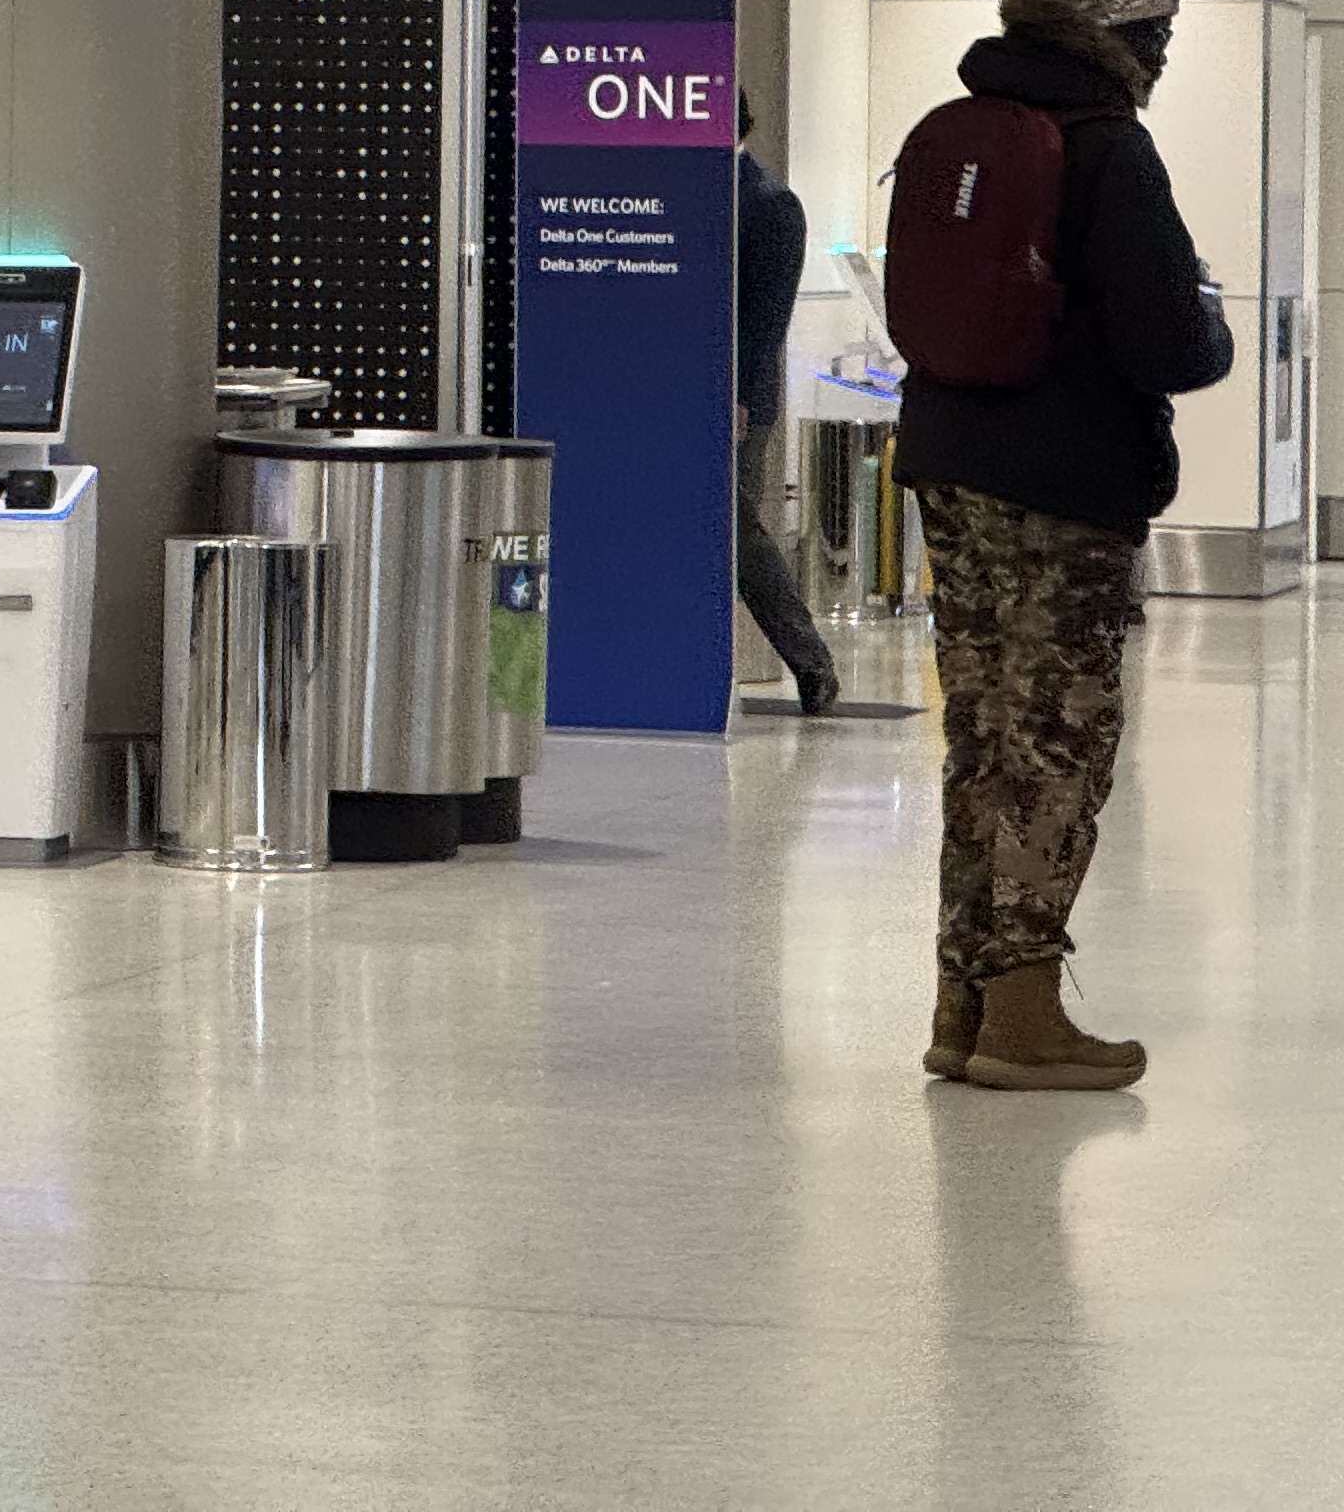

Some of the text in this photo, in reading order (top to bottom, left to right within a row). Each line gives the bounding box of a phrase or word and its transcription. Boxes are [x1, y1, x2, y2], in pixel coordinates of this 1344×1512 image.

[566, 45, 646, 63] DELTA
[588, 74, 711, 120] ONE
[540, 197, 665, 215] WE WELCOME:
[540, 227, 675, 245] Delta One Customers
[540, 257, 574, 272] Delta
[616, 258, 679, 275] Members
[5, 332, 29, 353] IN
